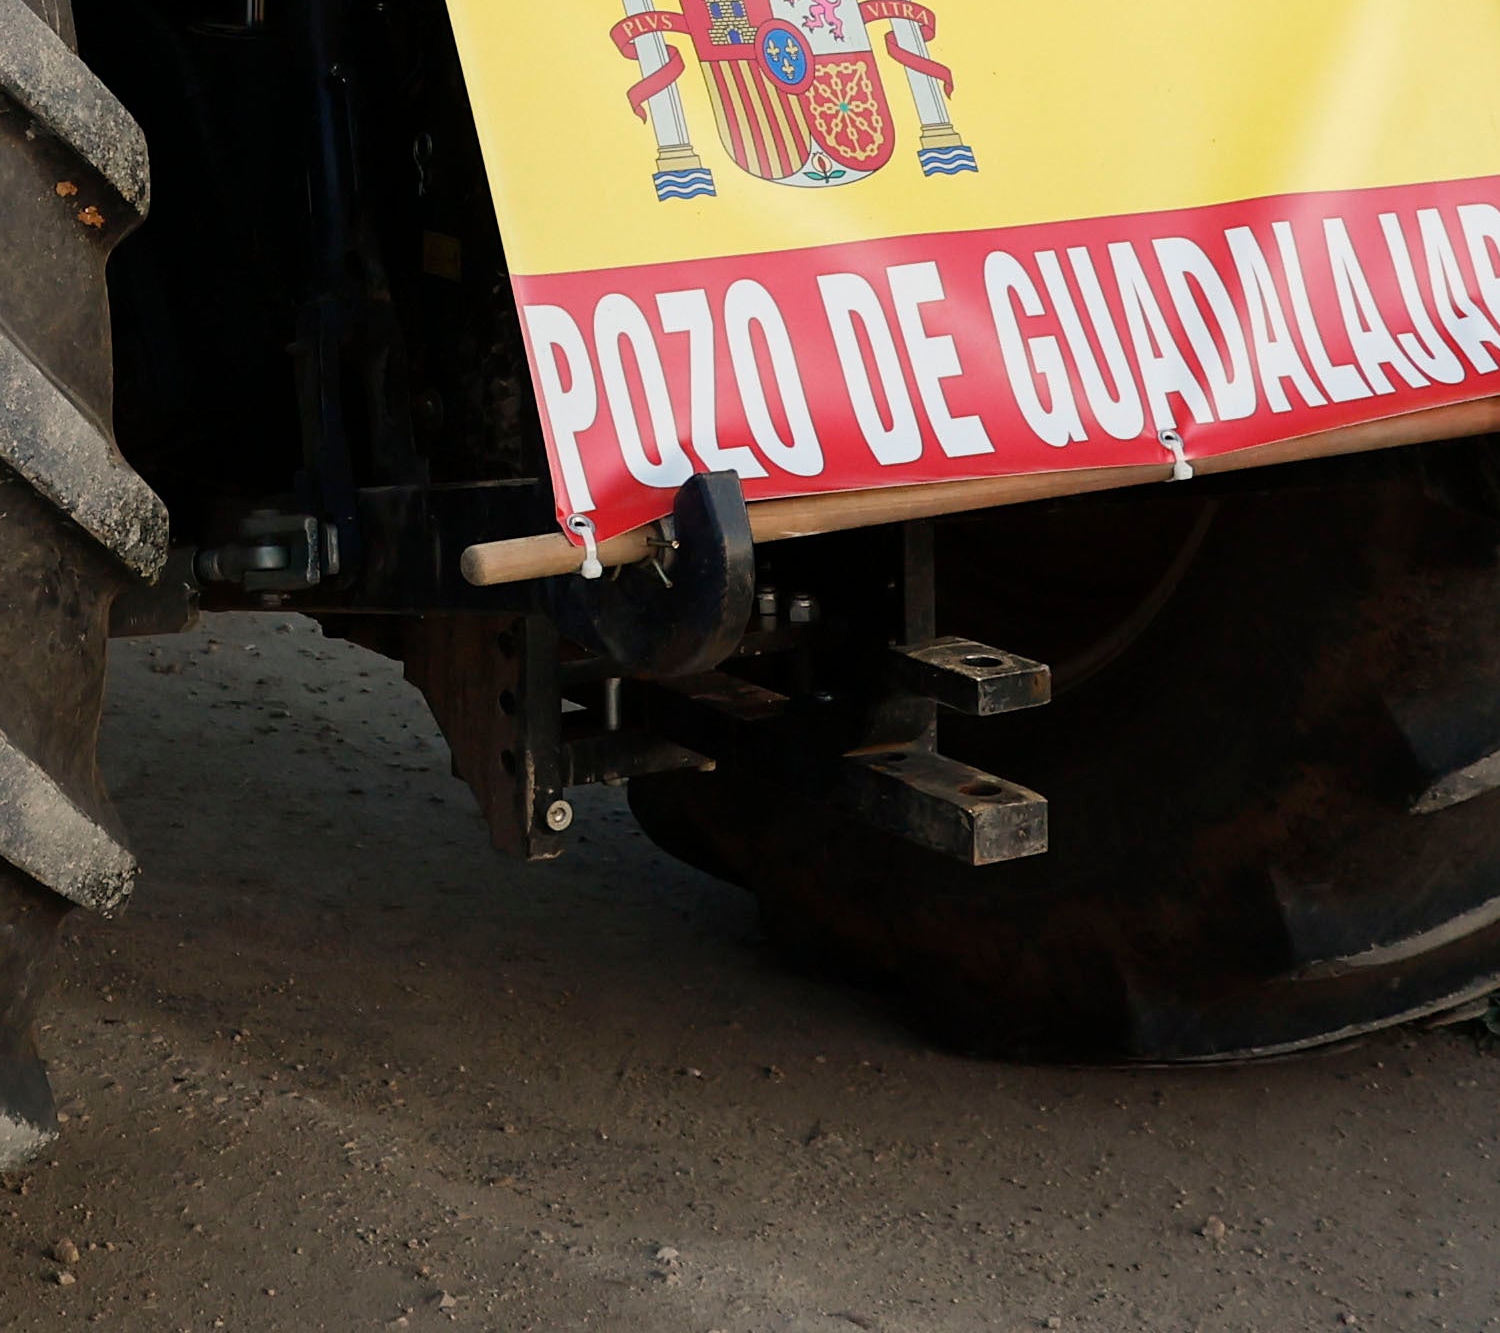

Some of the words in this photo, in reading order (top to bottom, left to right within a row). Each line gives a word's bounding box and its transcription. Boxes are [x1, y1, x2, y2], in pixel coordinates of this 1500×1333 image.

[622, 13, 674, 37] PLVS
[524, 278, 825, 513] POZO
[817, 260, 995, 467] DE
